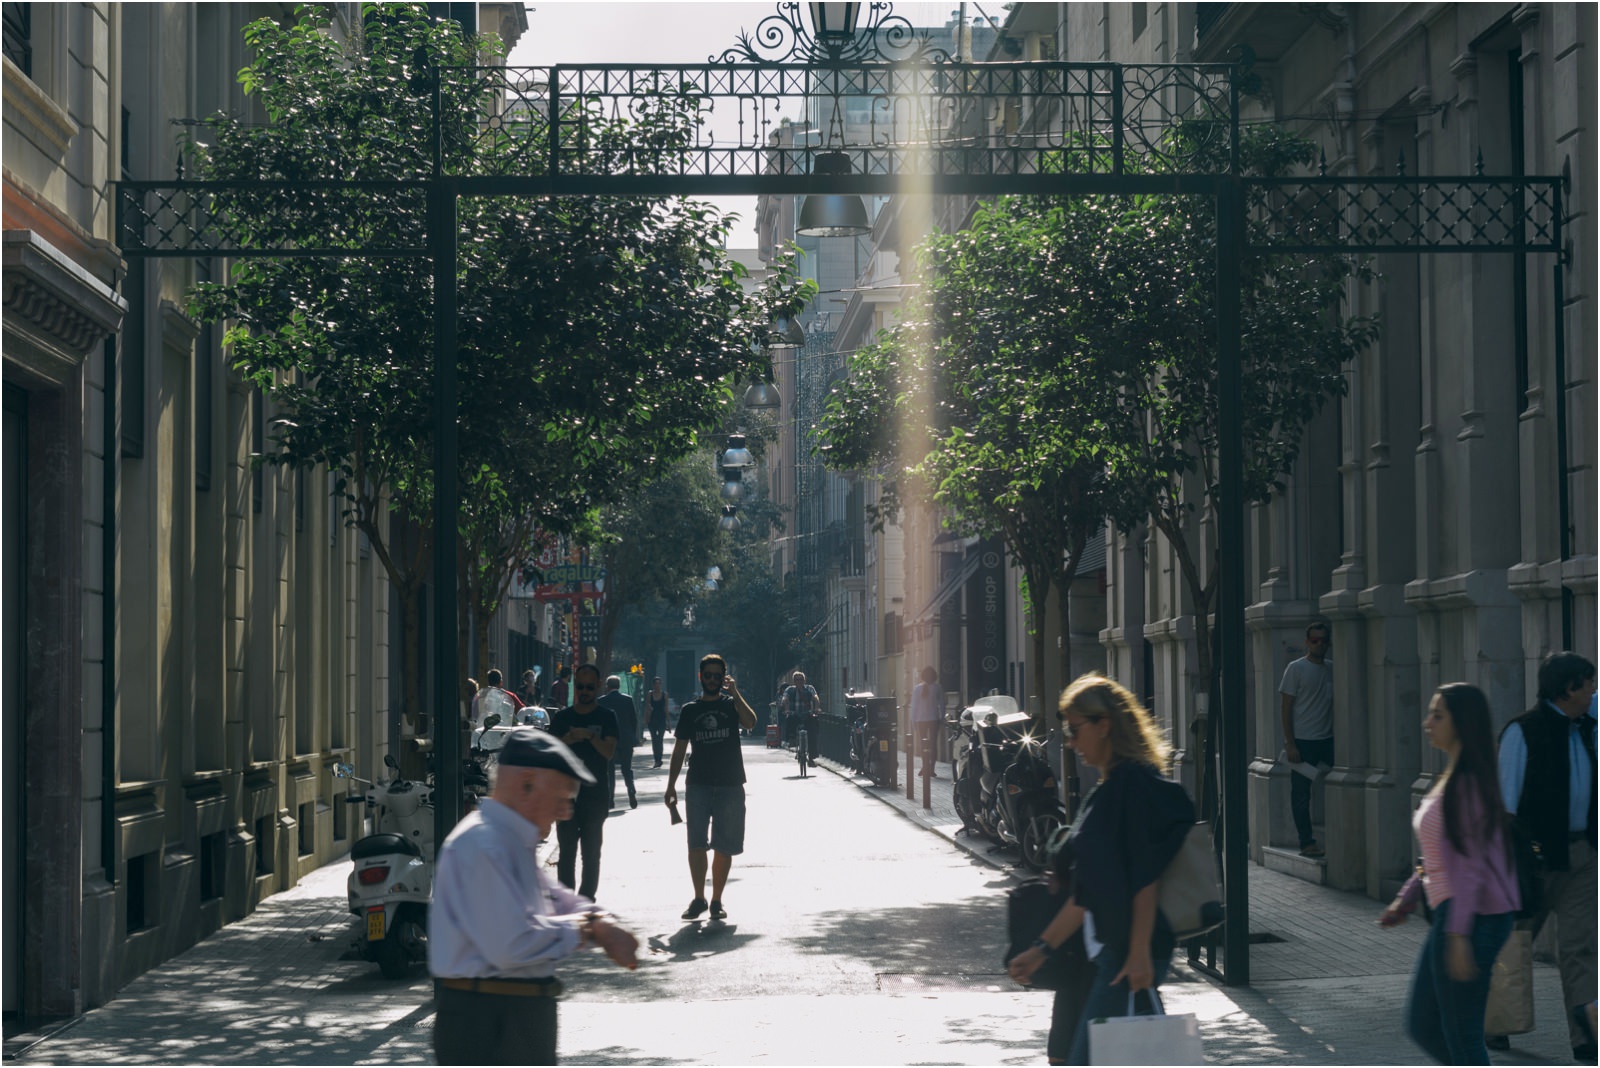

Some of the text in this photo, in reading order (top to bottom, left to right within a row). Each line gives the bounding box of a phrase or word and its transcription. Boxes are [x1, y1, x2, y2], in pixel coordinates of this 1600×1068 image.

[739, 95, 782, 149] DE
[804, 95, 845, 149] LA
[534, 564, 600, 584] ragaluz
